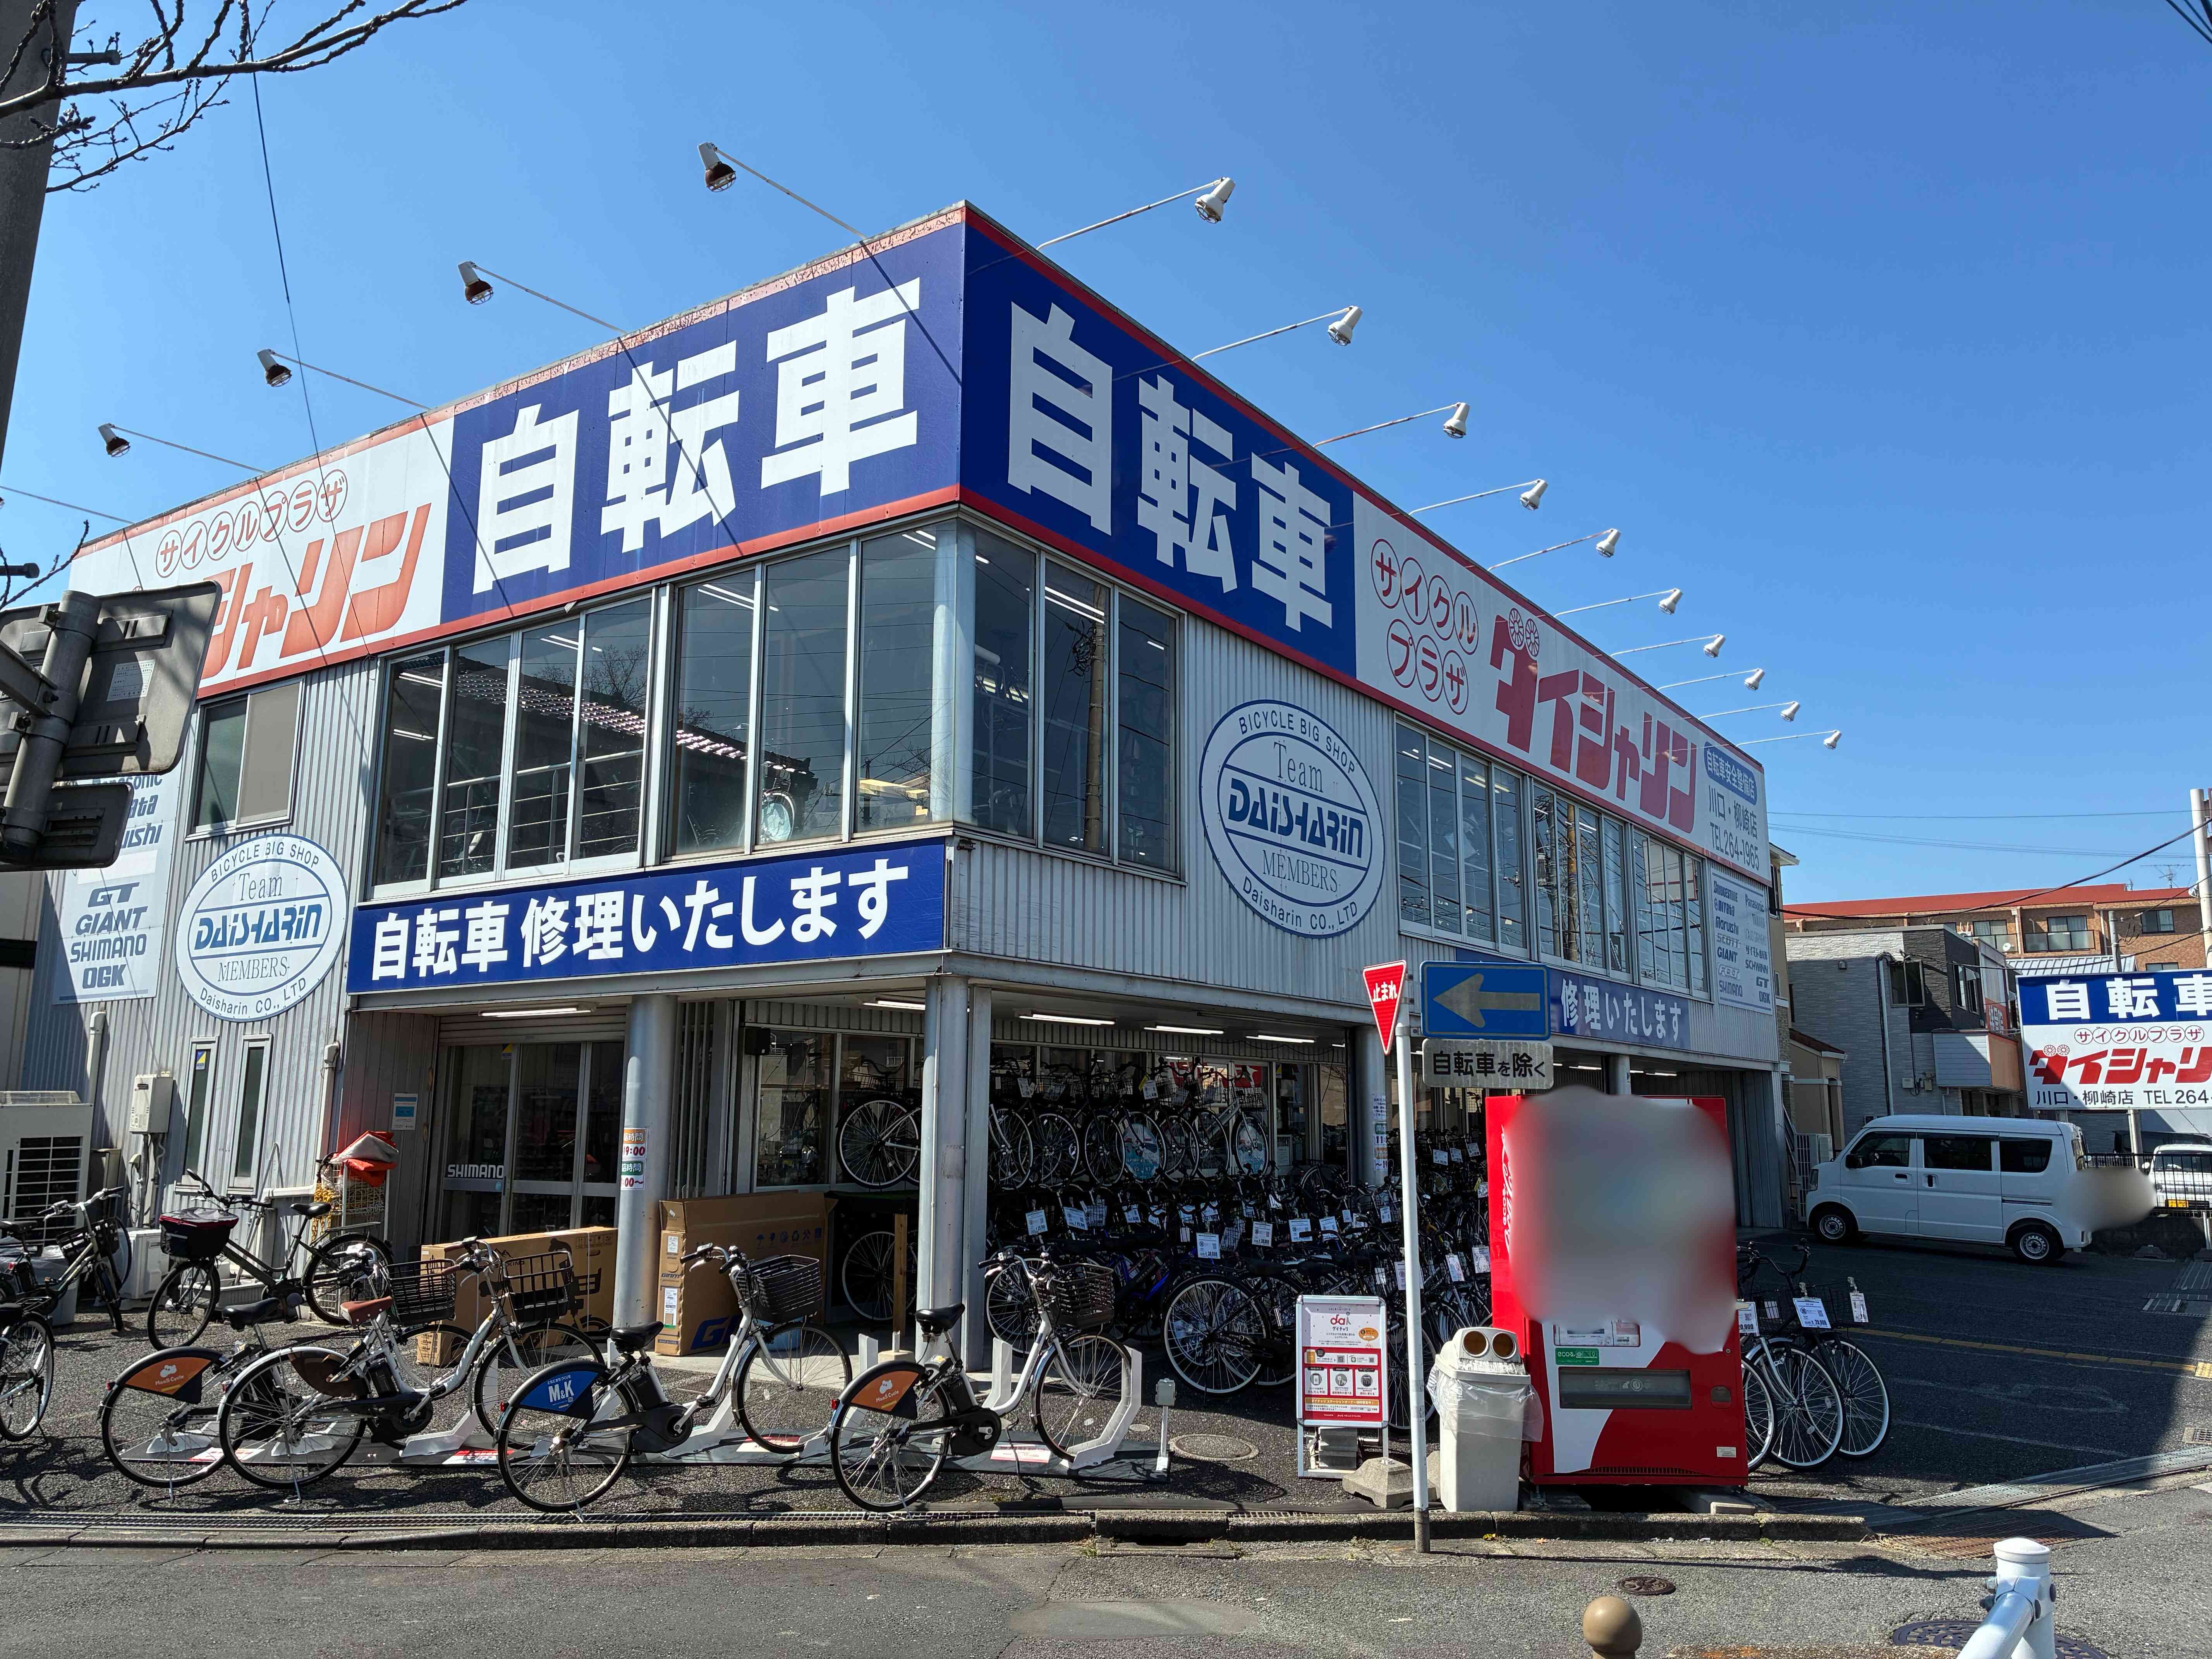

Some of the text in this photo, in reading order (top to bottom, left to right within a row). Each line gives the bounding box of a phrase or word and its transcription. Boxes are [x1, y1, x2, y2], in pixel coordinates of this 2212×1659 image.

[473, 278, 920, 594] 自転車
[1008, 301, 1332, 632] 自転車
[157, 472, 347, 575] サイクルプラザ
[1373, 543, 1477, 651] サイクル
[1389, 623, 1467, 711] プラザ
[1239, 710, 1355, 774] BICYCLE BIG SHOP
[1274, 741, 1324, 793] Team
[211, 842, 319, 882] BICYCLE BIG SHOP
[1710, 822, 1759, 871] TEL 264-1965
[239, 873, 282, 901] Team
[1262, 850, 1338, 893] MEMBERS
[88, 882, 140, 907] GT
[1243, 876, 1302, 927] Daisharin
[1337, 901, 1357, 925] LTD
[76, 906, 148, 936] GIANT
[372, 859, 908, 981] 自転車 修理いたします
[70, 934, 147, 963] SHIMANO
[1717, 946, 1738, 963] GIANT
[82, 964, 126, 989] OGK
[218, 957, 288, 982] MEMBERS
[1745, 959, 1768, 974] SCHWINN
[1756, 976, 1769, 988] GT
[200, 987, 248, 1015] Daisharin
[283, 977, 306, 1001] LTD
[1372, 980, 1398, 1003] 止まれ
[1719, 980, 1743, 997] SHIMANO
[2046, 974, 2212, 1020] 自転車
[1561, 978, 1682, 1042] 修理いたします
[1433, 1051, 1546, 1078] 自転車を除く
[2037, 1089, 2212, 1106] 川口・柳崎店 TEL 264
[447, 1164, 504, 1178] SHIMANO
[548, 1380, 574, 1402] M&K
